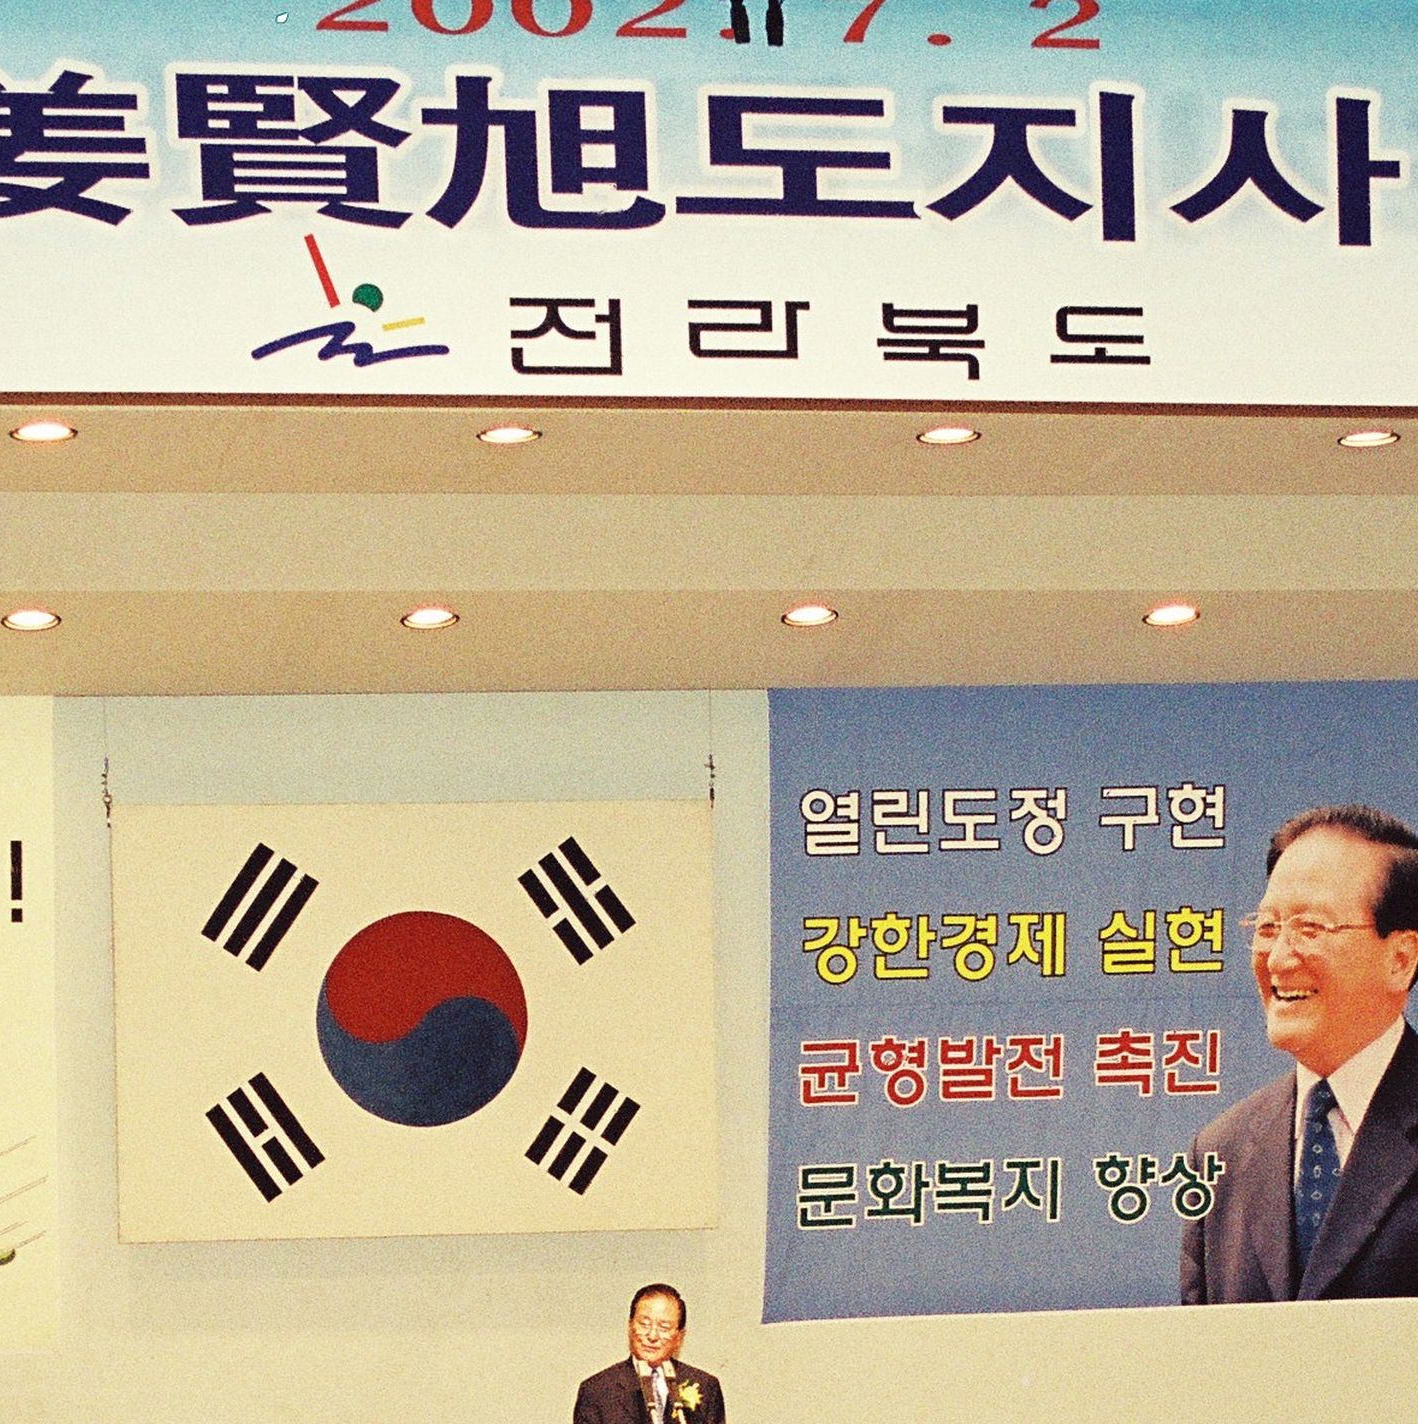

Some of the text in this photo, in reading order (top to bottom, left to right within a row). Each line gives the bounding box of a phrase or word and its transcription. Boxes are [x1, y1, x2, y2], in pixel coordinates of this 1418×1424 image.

[1029, 0, 1100, 49] 2
[510, 297, 1151, 380] 전라북도
[799, 781, 1226, 857] 열린도정 구현
[802, 906, 1225, 984] 강한경제 실현
[798, 1029, 1220, 1108] 균형발전 촉진
[797, 1152, 1225, 1230] 문화복지 향상
